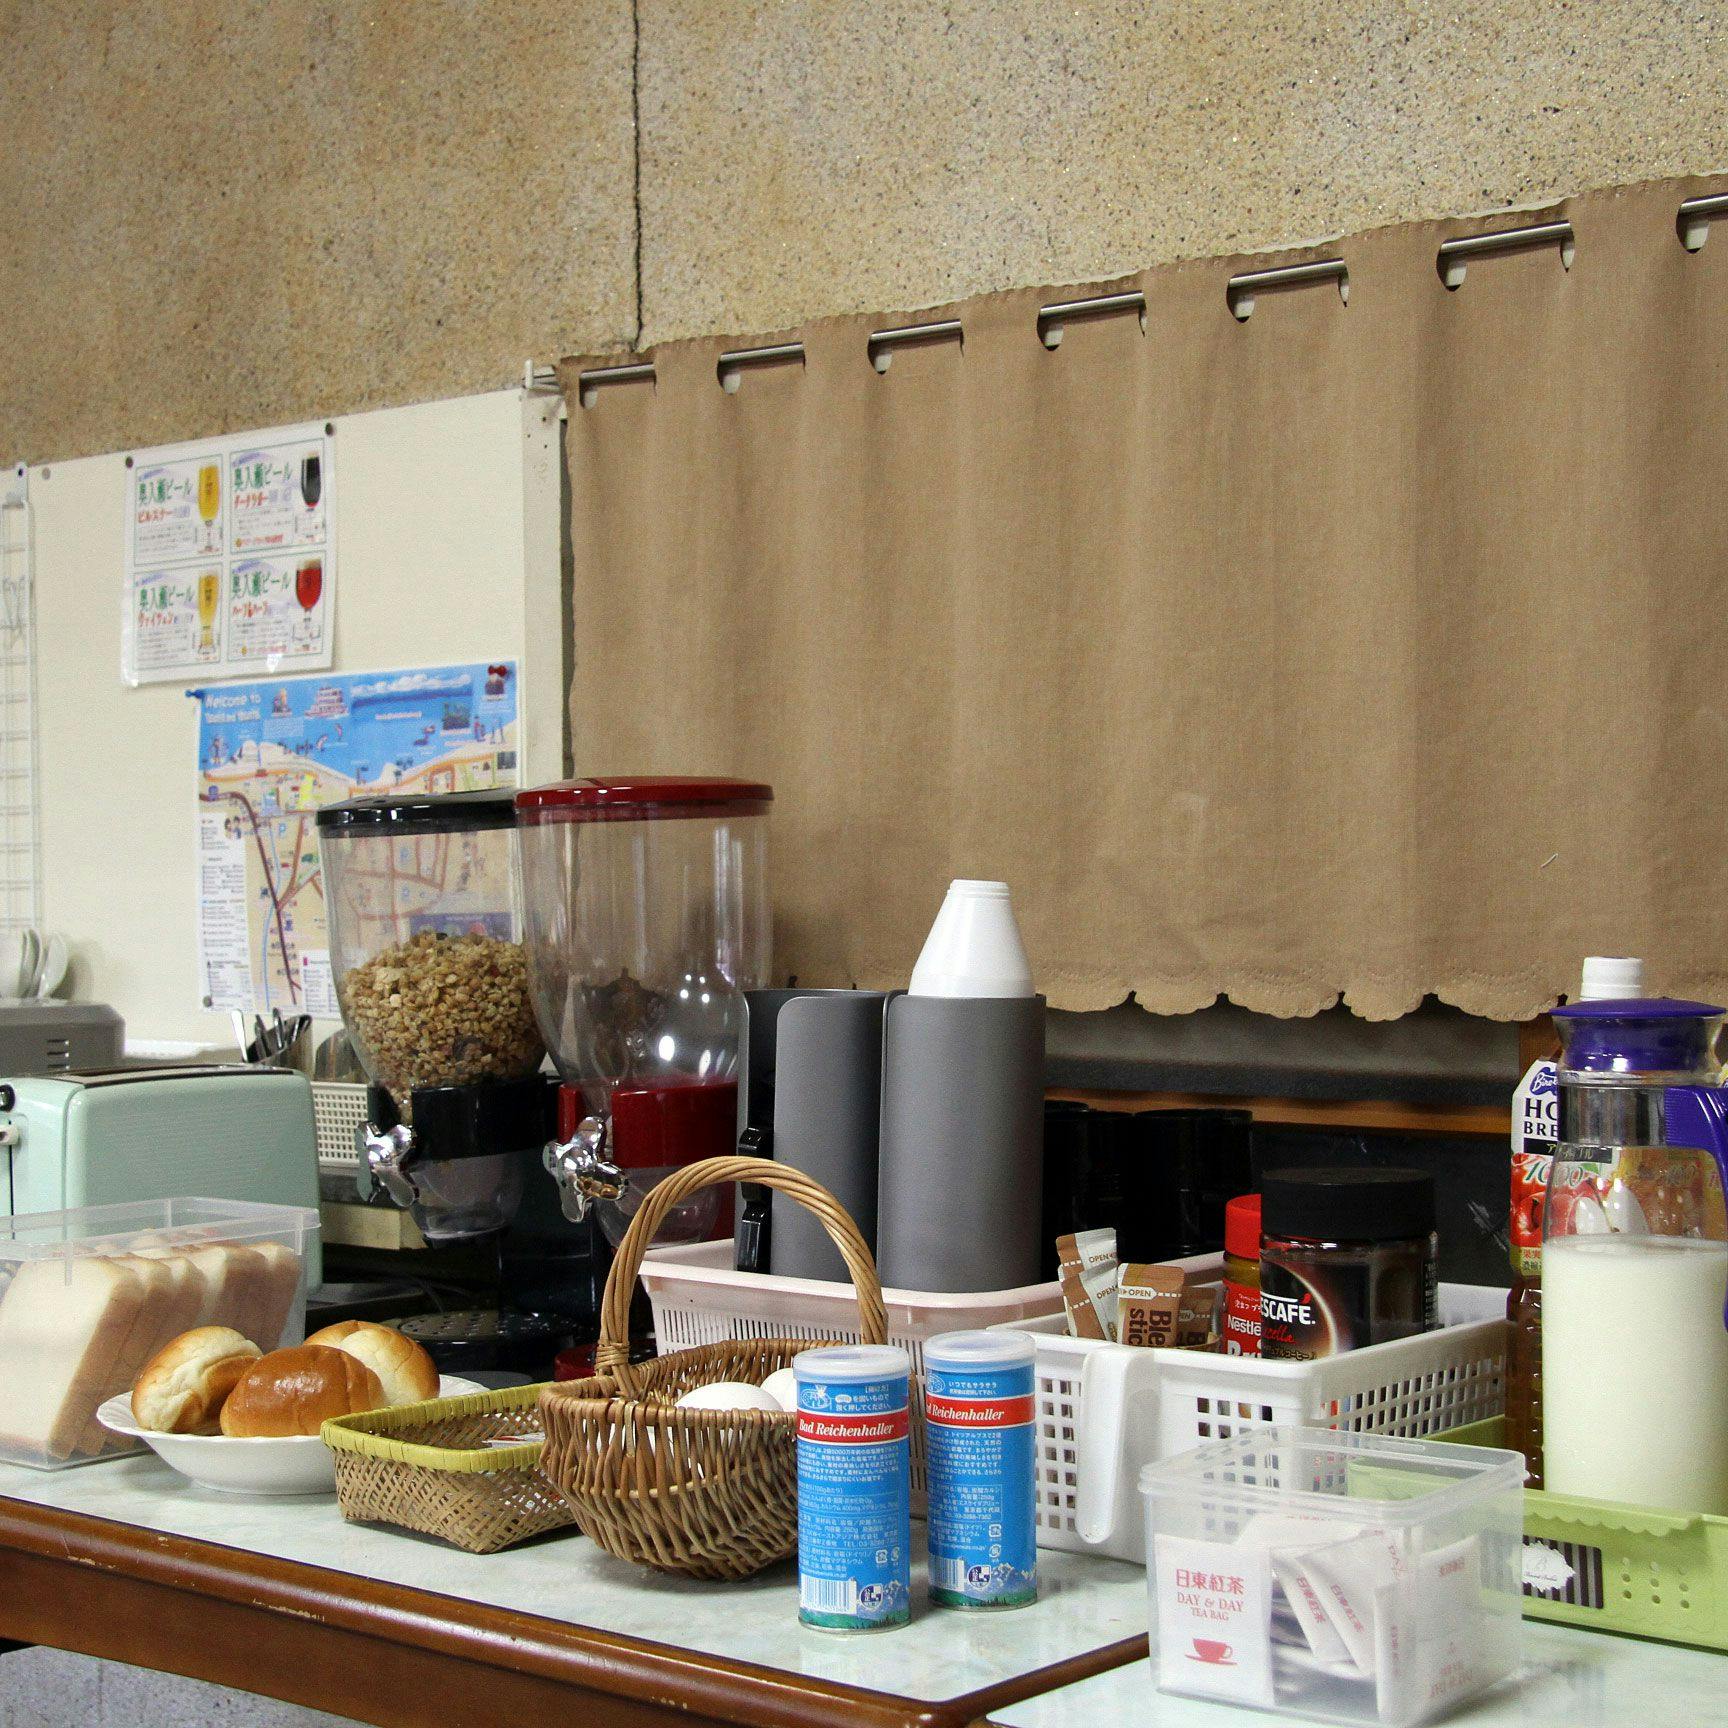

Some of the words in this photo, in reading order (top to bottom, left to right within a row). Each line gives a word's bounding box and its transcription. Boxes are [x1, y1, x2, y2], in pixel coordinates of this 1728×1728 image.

[1088, 1253, 1110, 1263] OPEN
[1096, 1286, 1115, 1299] OPEN
[1128, 1289, 1151, 1297] OPEN
[932, 1404, 1005, 1421] Reichenhaller
[799, 1418, 815, 1434] Bad
[816, 1422, 895, 1437] Reichenhaller
[1176, 1568, 1244, 1595] 日東紅茶
[1177, 1592, 1200, 1608] DAY
[1204, 1597, 1214, 1608] &
[1219, 1597, 1244, 1612] DAY
[1191, 1606, 1208, 1618] TEA
[1210, 1609, 1229, 1621] BAG
